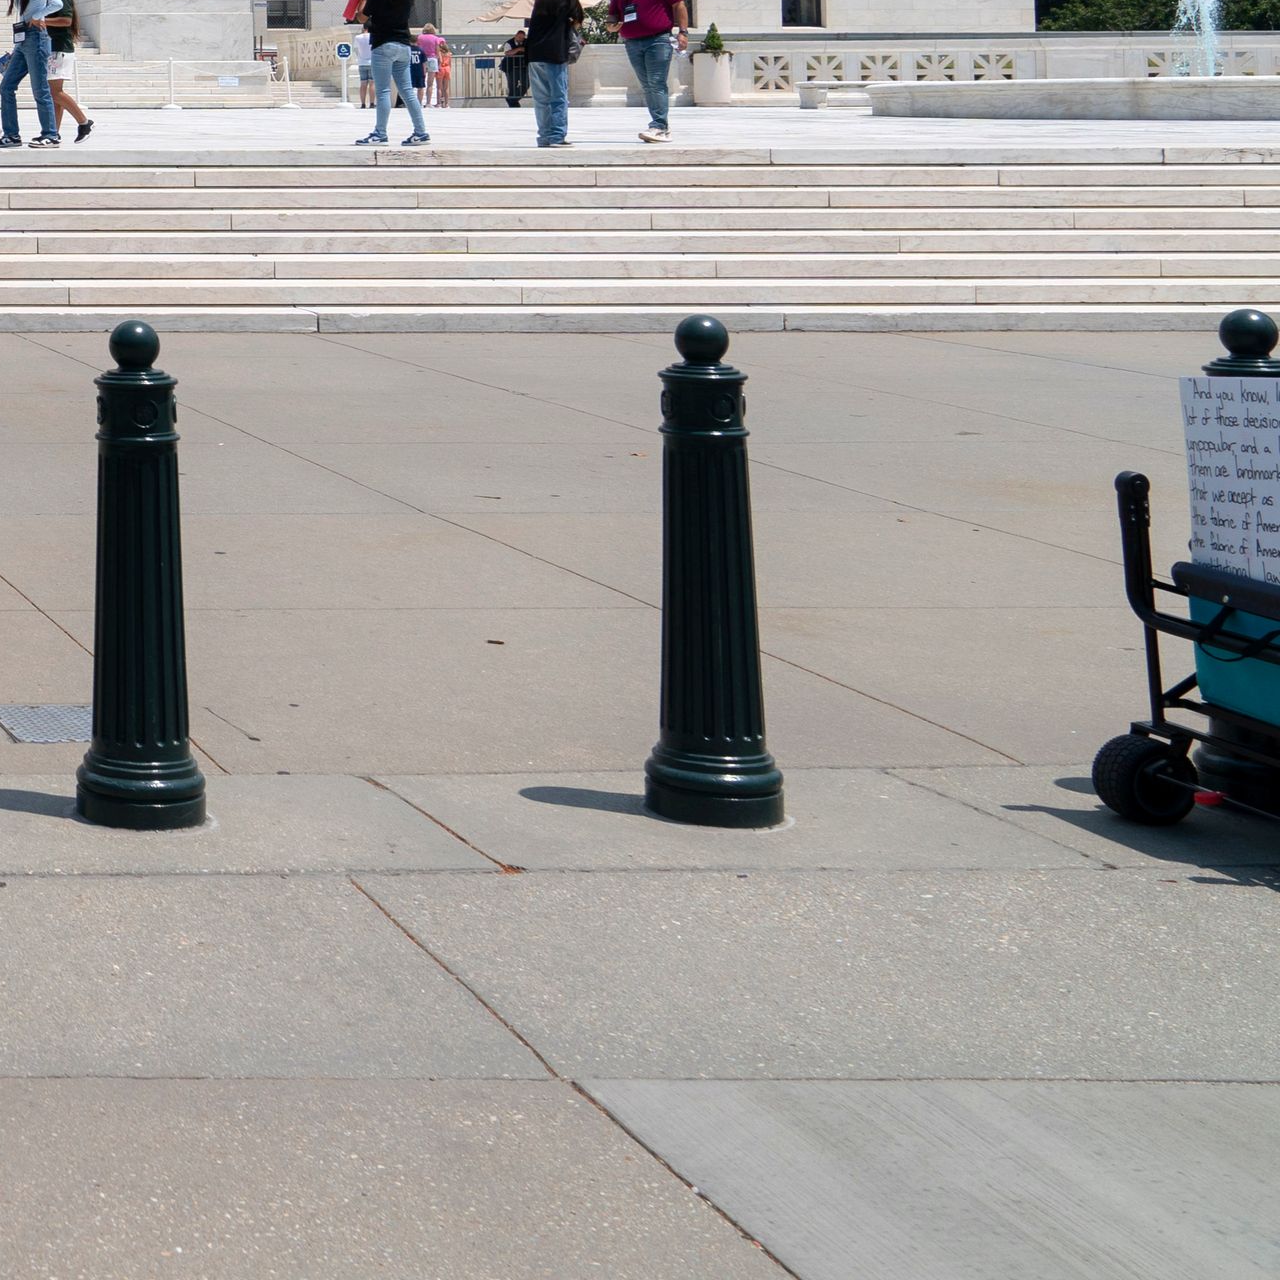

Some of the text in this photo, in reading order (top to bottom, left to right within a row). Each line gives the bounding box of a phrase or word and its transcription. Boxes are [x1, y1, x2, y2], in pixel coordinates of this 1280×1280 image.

[1215, 391, 1235, 410] you
[1201, 407, 1211, 426] of
[1214, 406, 1240, 427] those
[1243, 408, 1280, 429] decisio
[1241, 437, 1259, 455] and
[1263, 446, 1271, 454] a
[1190, 455, 1212, 478] them
[1215, 465, 1230, 477] are
[1191, 480, 1274, 508] that we accept as
[1192, 506, 1207, 526] the
[1210, 506, 1236, 529] fabric
[1242, 512, 1251, 530] of
[1194, 531, 1206, 548] the
[1210, 531, 1236, 554] fabric
[1239, 538, 1248, 555] of
